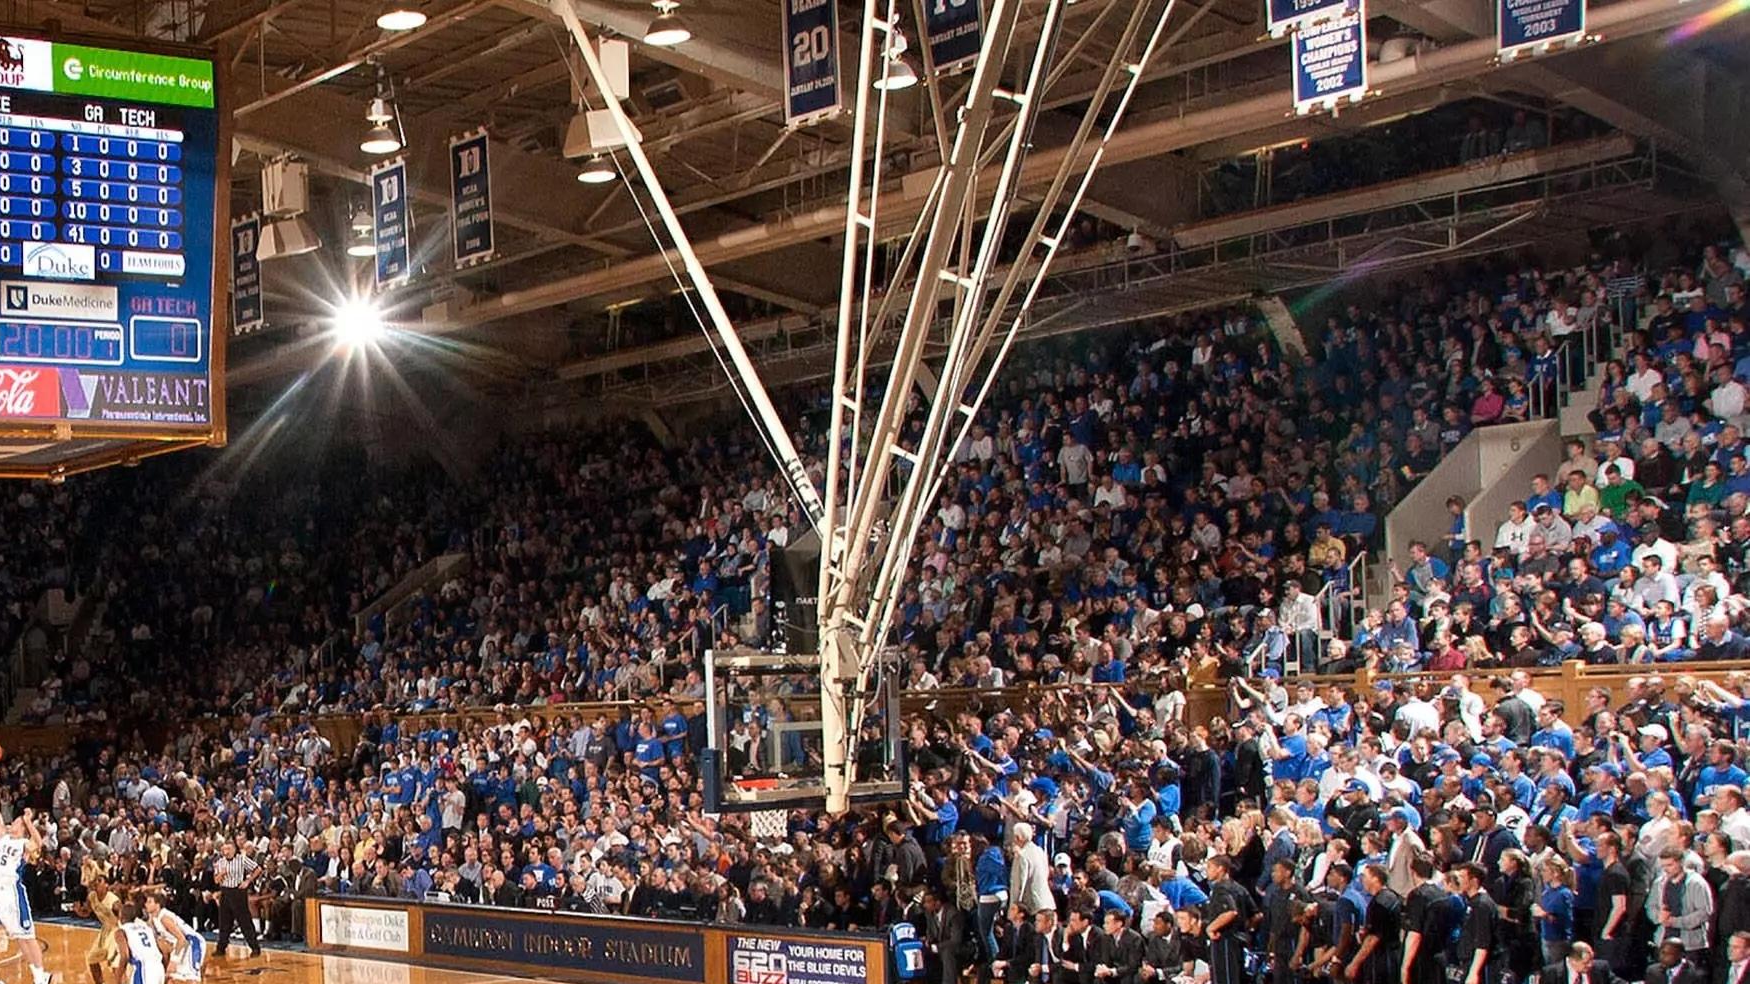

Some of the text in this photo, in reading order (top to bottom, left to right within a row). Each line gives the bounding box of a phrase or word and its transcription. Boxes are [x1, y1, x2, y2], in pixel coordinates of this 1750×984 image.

[1523, 19, 1556, 37] 2003
[793, 25, 829, 67] 20
[89, 63, 212, 93] Circumference Group
[1316, 74, 1344, 92] 2002
[84, 104, 155, 128] GA TECH
[0, 128, 9, 145] 0
[31, 131, 41, 148] 0
[72, 136, 168, 160] 1 0 0 0
[0, 152, 10, 169] 0
[31, 155, 41, 172] 0
[72, 159, 167, 183] 3 0 0 0
[0, 174, 10, 192] 0
[31, 177, 41, 194] 0
[72, 180, 168, 204] 5 0 0 0
[0, 196, 10, 214] 0
[32, 199, 41, 216] 0
[69, 203, 168, 226] 10 0 0 0
[0, 221, 10, 238] 0
[32, 223, 41, 240] 0
[68, 225, 168, 249] 41 0 0 0
[0, 245, 10, 262] 0
[101, 252, 110, 269] 0
[38, 255, 89, 275] Duke
[32, 294, 113, 309] DukeMedicine
[130, 296, 197, 314] GA TECH
[94, 330, 120, 341] PERIOD
[170, 323, 187, 355] 0
[100, 375, 207, 407] VALEANT
[384, 914, 405, 928] Duke
[138, 931, 151, 948] 2
[364, 927, 381, 941] Golf
[383, 929, 401, 942] Club
[737, 937, 782, 951] THE NEW
[431, 924, 693, 968] CAMERON INDOOR STADIUM
[788, 945, 865, 962] YOUR HOME FOR
[734, 950, 787, 972] 620
[787, 959, 866, 978] THE BLUE DEVILS
